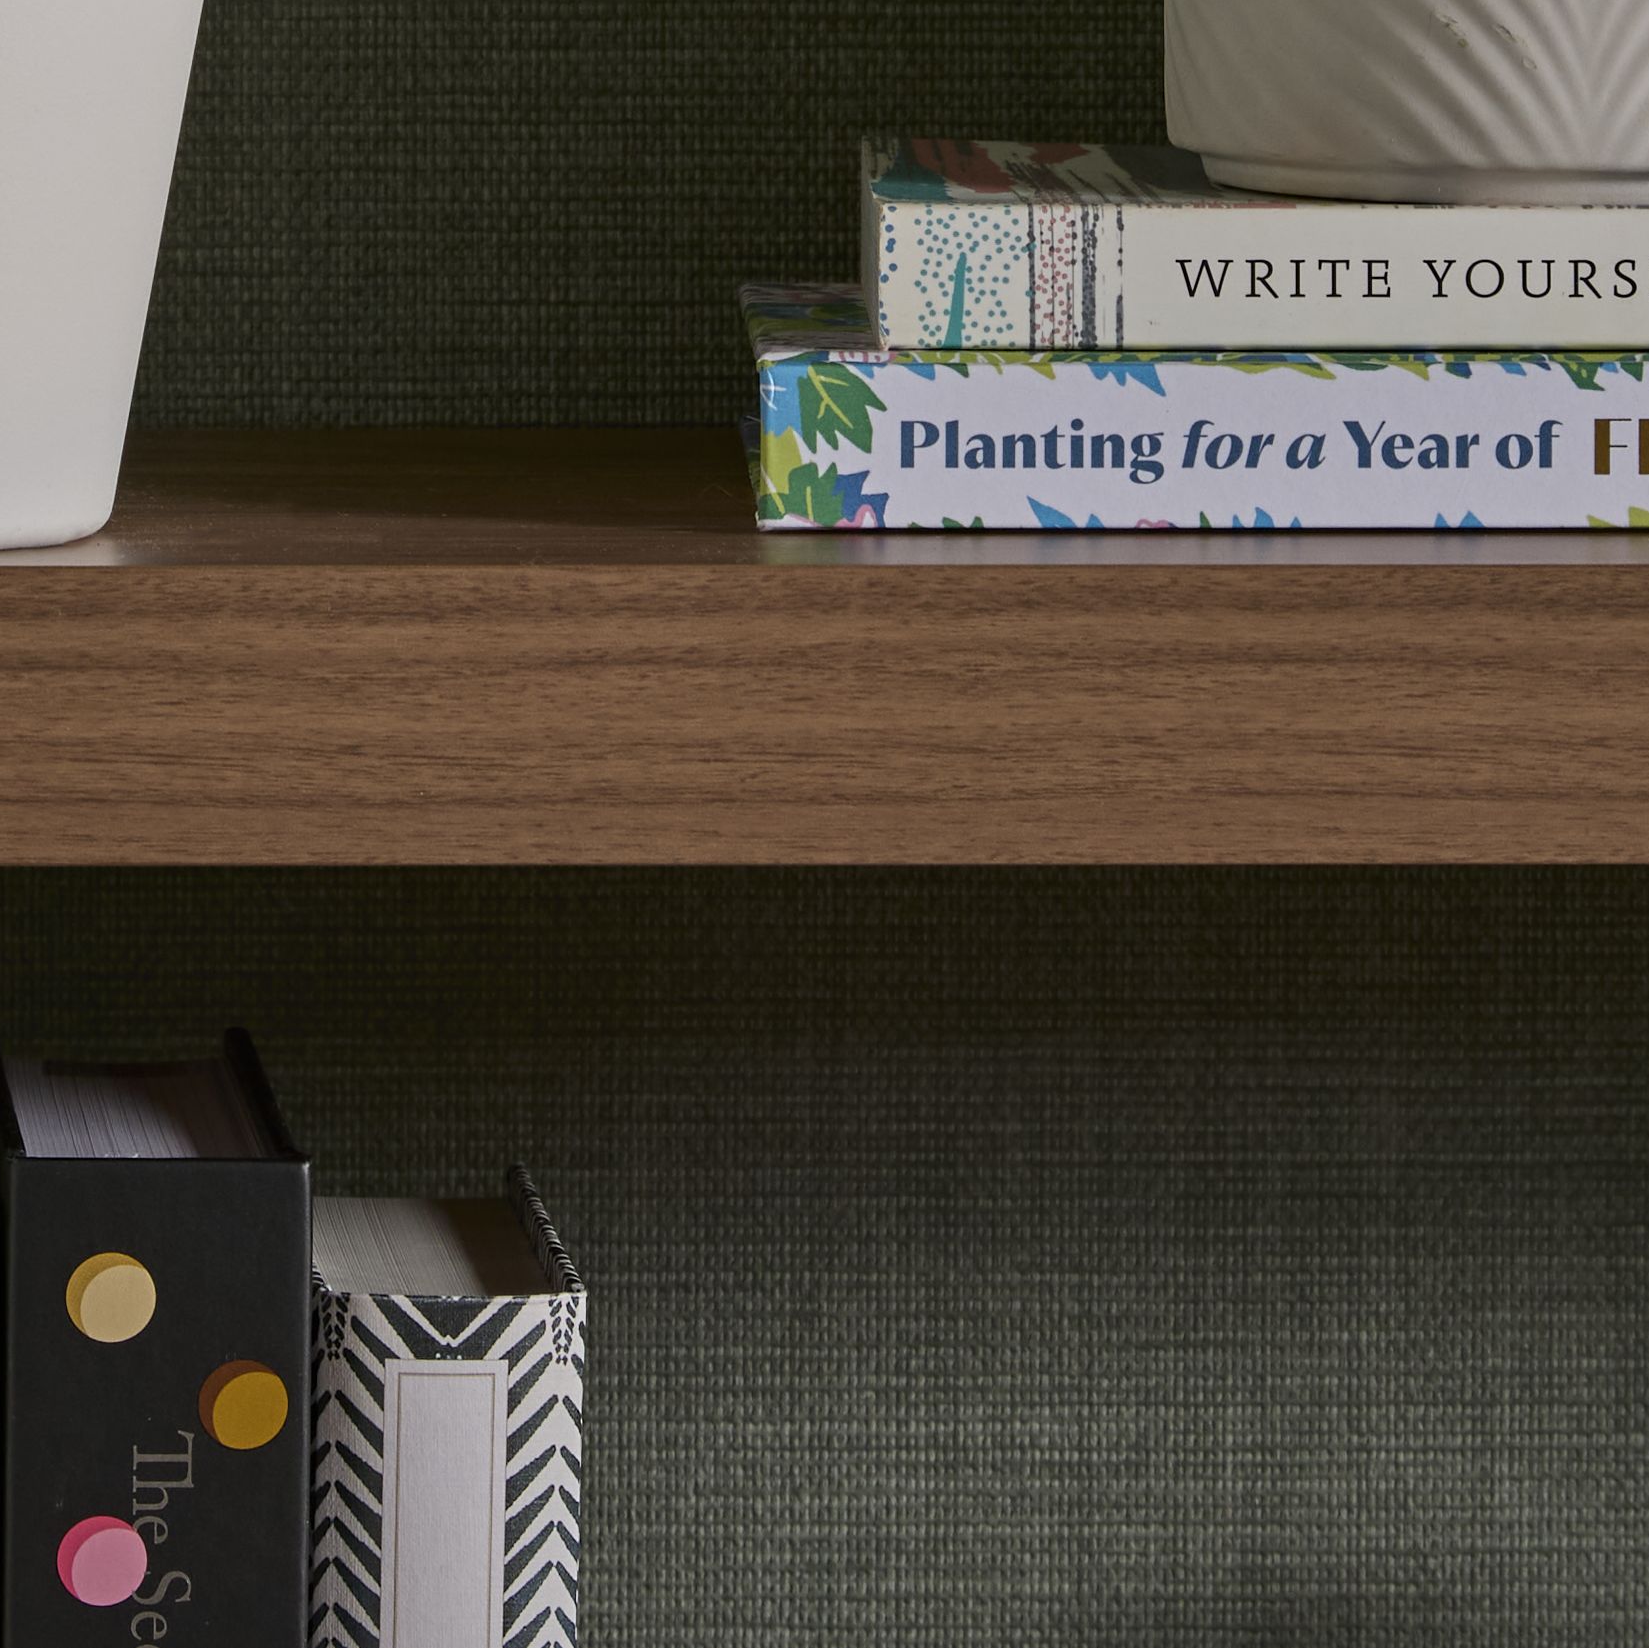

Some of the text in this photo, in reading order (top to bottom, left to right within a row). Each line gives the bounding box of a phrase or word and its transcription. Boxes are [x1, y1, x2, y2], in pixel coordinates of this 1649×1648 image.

[1175, 258, 1392, 300] WRITE
[899, 417, 1165, 485] Planting
[1181, 418, 1276, 471] for
[1284, 432, 1328, 471] a
[1341, 419, 1481, 471] Year
[1494, 418, 1564, 471] of
[130, 1429, 195, 1648] The Se
